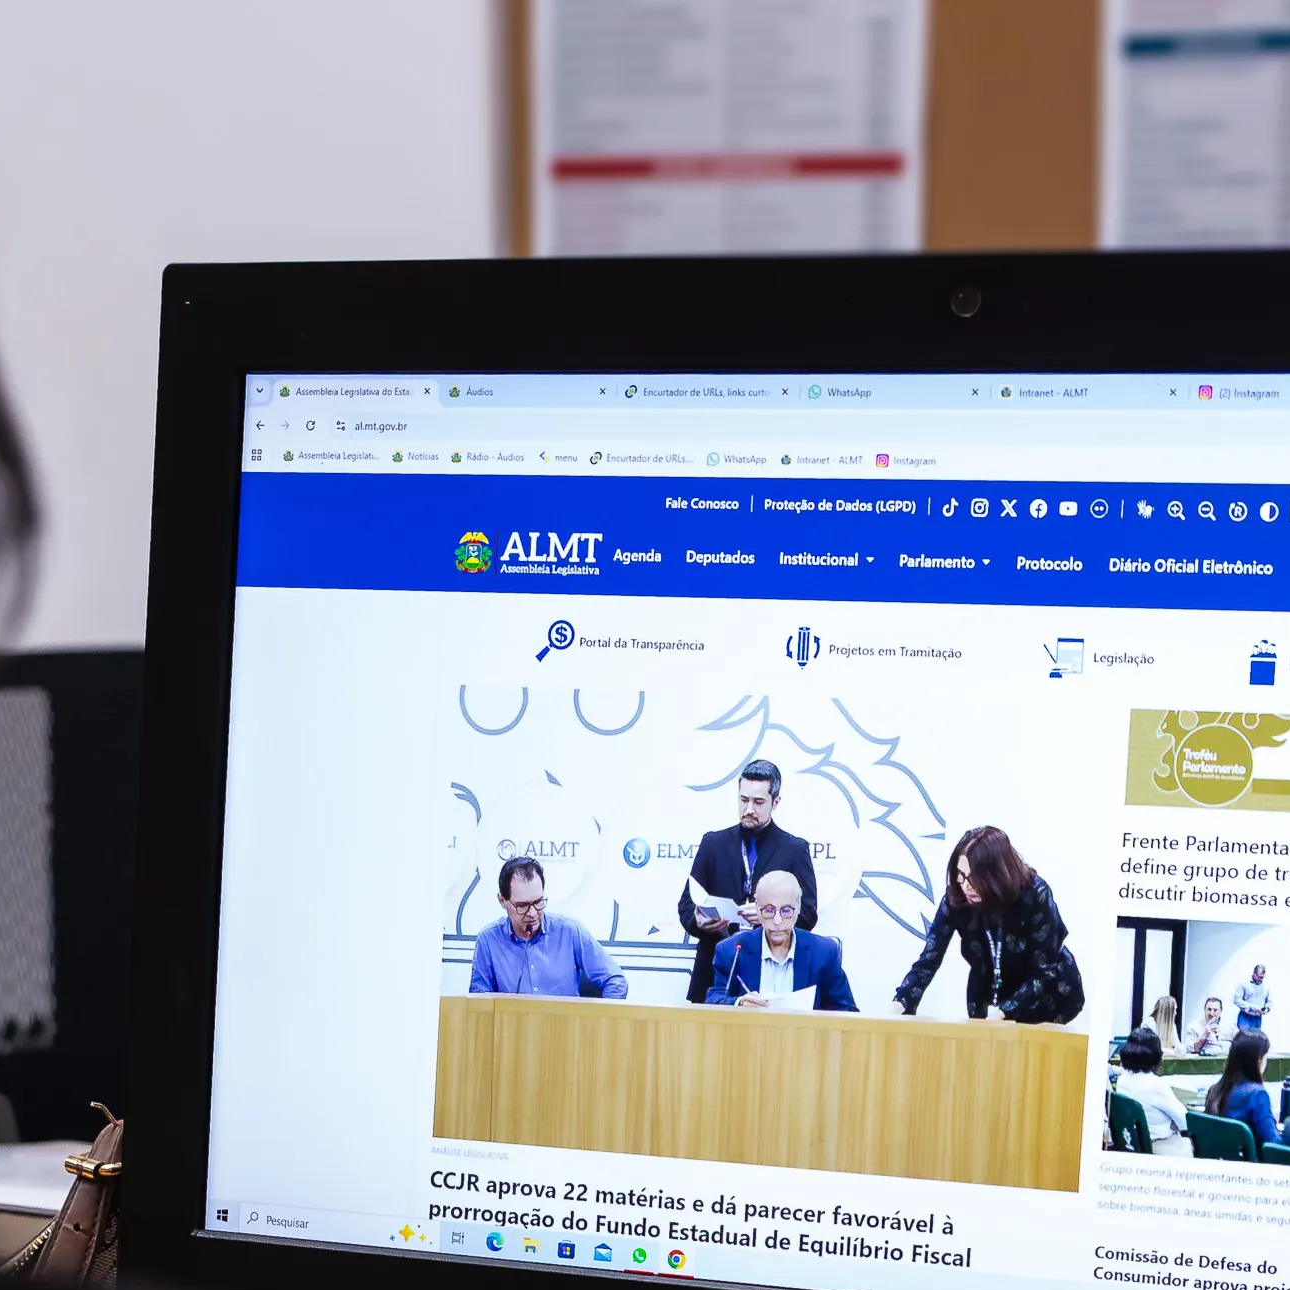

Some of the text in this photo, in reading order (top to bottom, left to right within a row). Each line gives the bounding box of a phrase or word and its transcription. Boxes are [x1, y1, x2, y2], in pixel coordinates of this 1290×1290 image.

[296, 387, 392, 398] Assembleia Legislativa do
[466, 387, 494, 397] Áudios
[643, 387, 746, 399] Encurtador de URLs, links
[827, 388, 872, 399] WhatsApp
[1019, 388, 1088, 398] Intranet ALMT
[1219, 389, 1280, 401] (2) Instagram
[355, 421, 408, 433] al.mt.gov.br
[298, 451, 340, 461] Assembleia
[408, 451, 439, 461] Notícias
[467, 451, 524, 462] Rádio Áudios
[724, 455, 767, 466] WhatsApp
[797, 455, 863, 465] Intranet ALMT
[893, 456, 936, 467] Instagram
[665, 497, 740, 510] Fale Conosco
[764, 499, 916, 515] Proteção de Dados (LGPD)
[500, 532, 603, 563] ALMT
[613, 549, 662, 564] Agenda
[686, 550, 755, 566] Deputados
[779, 552, 859, 567] Institucional
[899, 554, 975, 568] Parlamento
[1017, 556, 1083, 571] Protocolo
[500, 563, 600, 576] Assembleia Legislativa
[1109, 557, 1274, 575] Diário Oficial Eletrônico
[579, 636, 705, 652] Portal da Transparência
[828, 643, 963, 662] Projetos em Tramitação
[1093, 652, 1155, 667] Legislação
[524, 840, 579, 858] ALMT
[1122, 833, 1179, 851] Frente
[1120, 858, 1177, 876] define
[1183, 865, 1239, 882] grupo
[1245, 863, 1268, 881] de
[1118, 883, 1186, 902] discutir
[1192, 887, 1278, 907] biomassa
[430, 1170, 954, 1236] CCJR aprova 22 matérias e dá parecer favorável à
[266, 1214, 309, 1230] Pesquisar
[428, 1202, 972, 1268] prorrogação do Fundo Estadual de Equilíbrio Fiscal
[1095, 1246, 1278, 1275] Comissão de Defesa do
[1093, 1266, 1189, 1290] Consumidor
